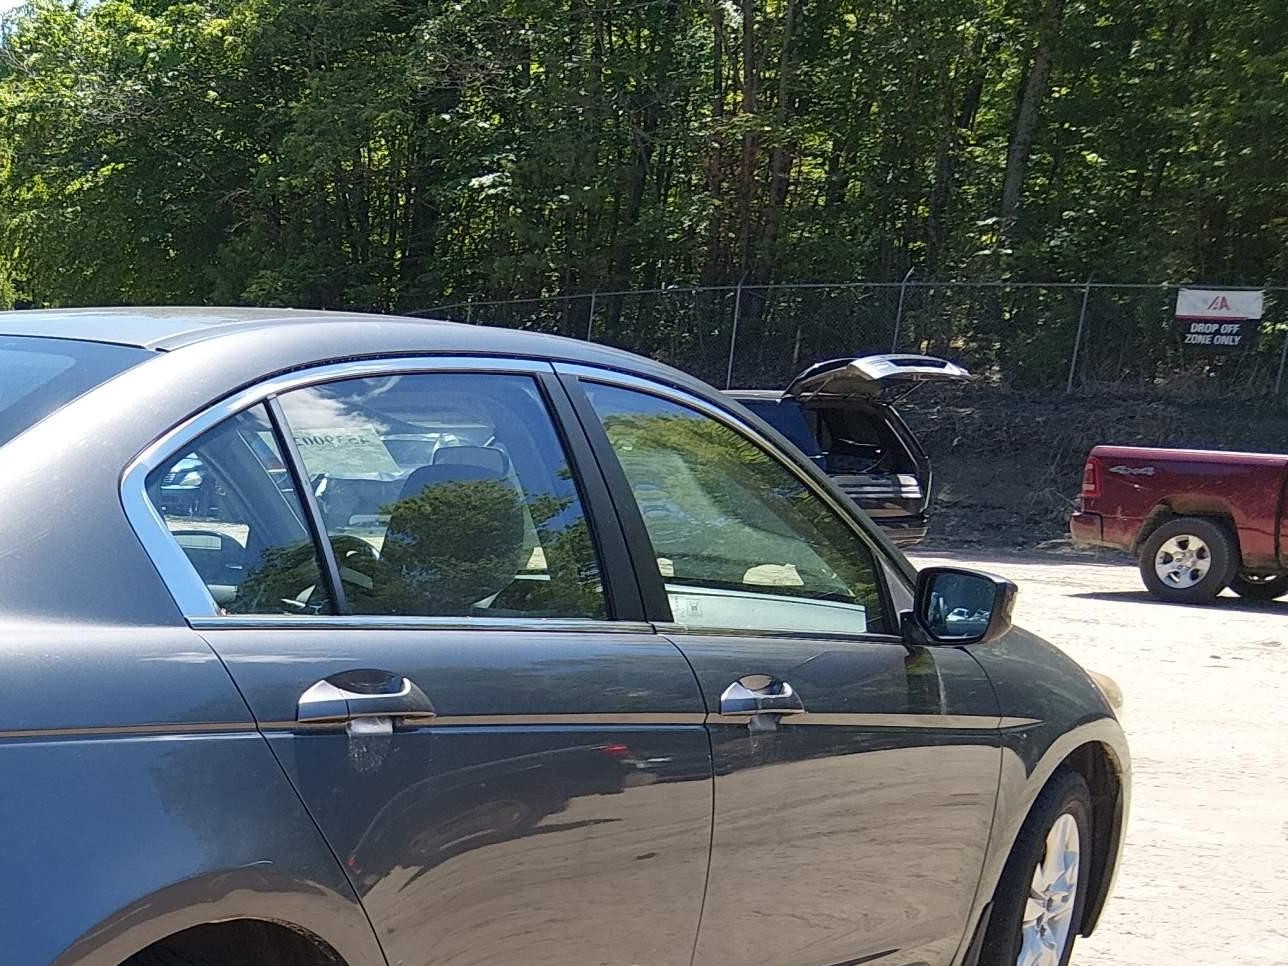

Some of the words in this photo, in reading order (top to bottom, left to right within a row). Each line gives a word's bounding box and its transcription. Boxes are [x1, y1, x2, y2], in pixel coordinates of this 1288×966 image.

[1190, 323, 1219, 333] DROP
[1220, 324, 1240, 334] OFF
[1184, 334, 1210, 344] ZONE
[1213, 335, 1242, 346] ONLY
